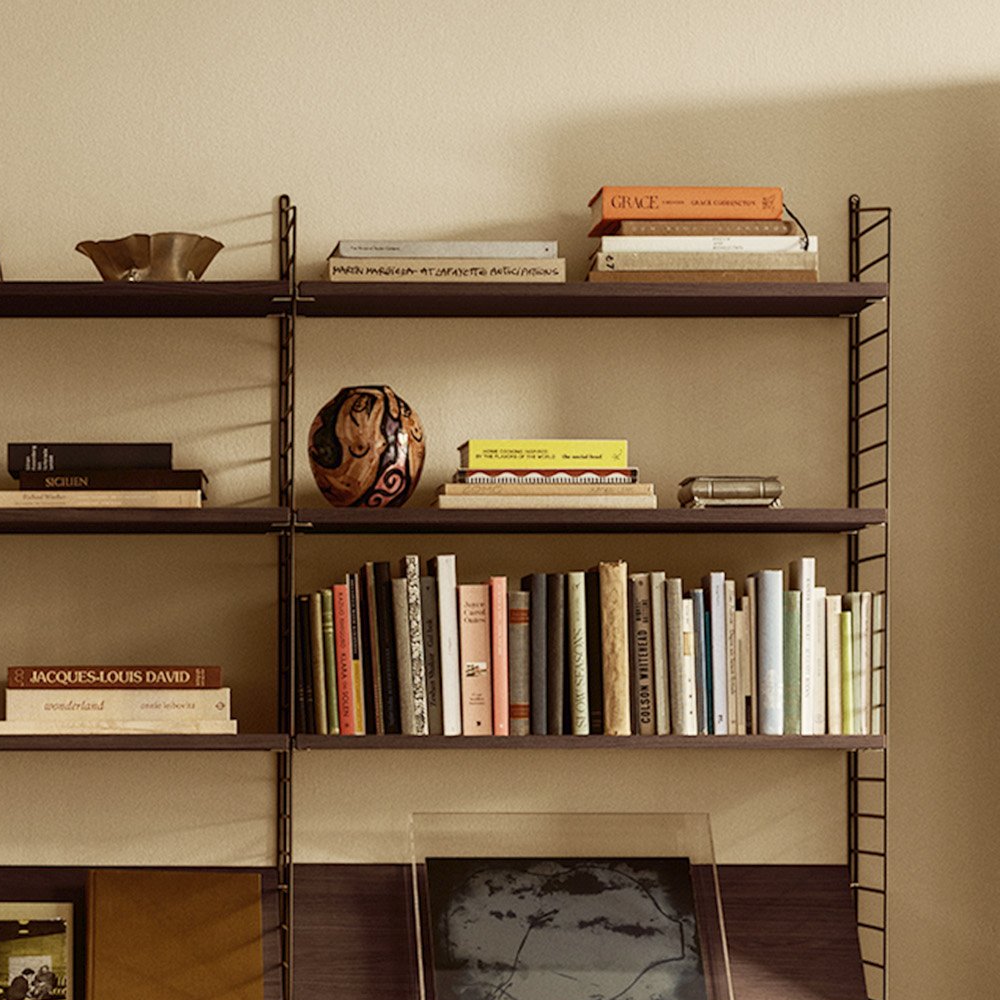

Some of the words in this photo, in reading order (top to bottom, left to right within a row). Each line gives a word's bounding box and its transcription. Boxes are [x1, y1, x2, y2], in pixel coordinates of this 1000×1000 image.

[611, 195, 659, 209] GRACE
[637, 630, 650, 681] WHITEHEAD
[30, 671, 142, 684] JACQUES-LOUIS
[146, 671, 191, 683] DAVID
[44, 700, 105, 712] wonderland
[640, 687, 651, 724] COLSON
